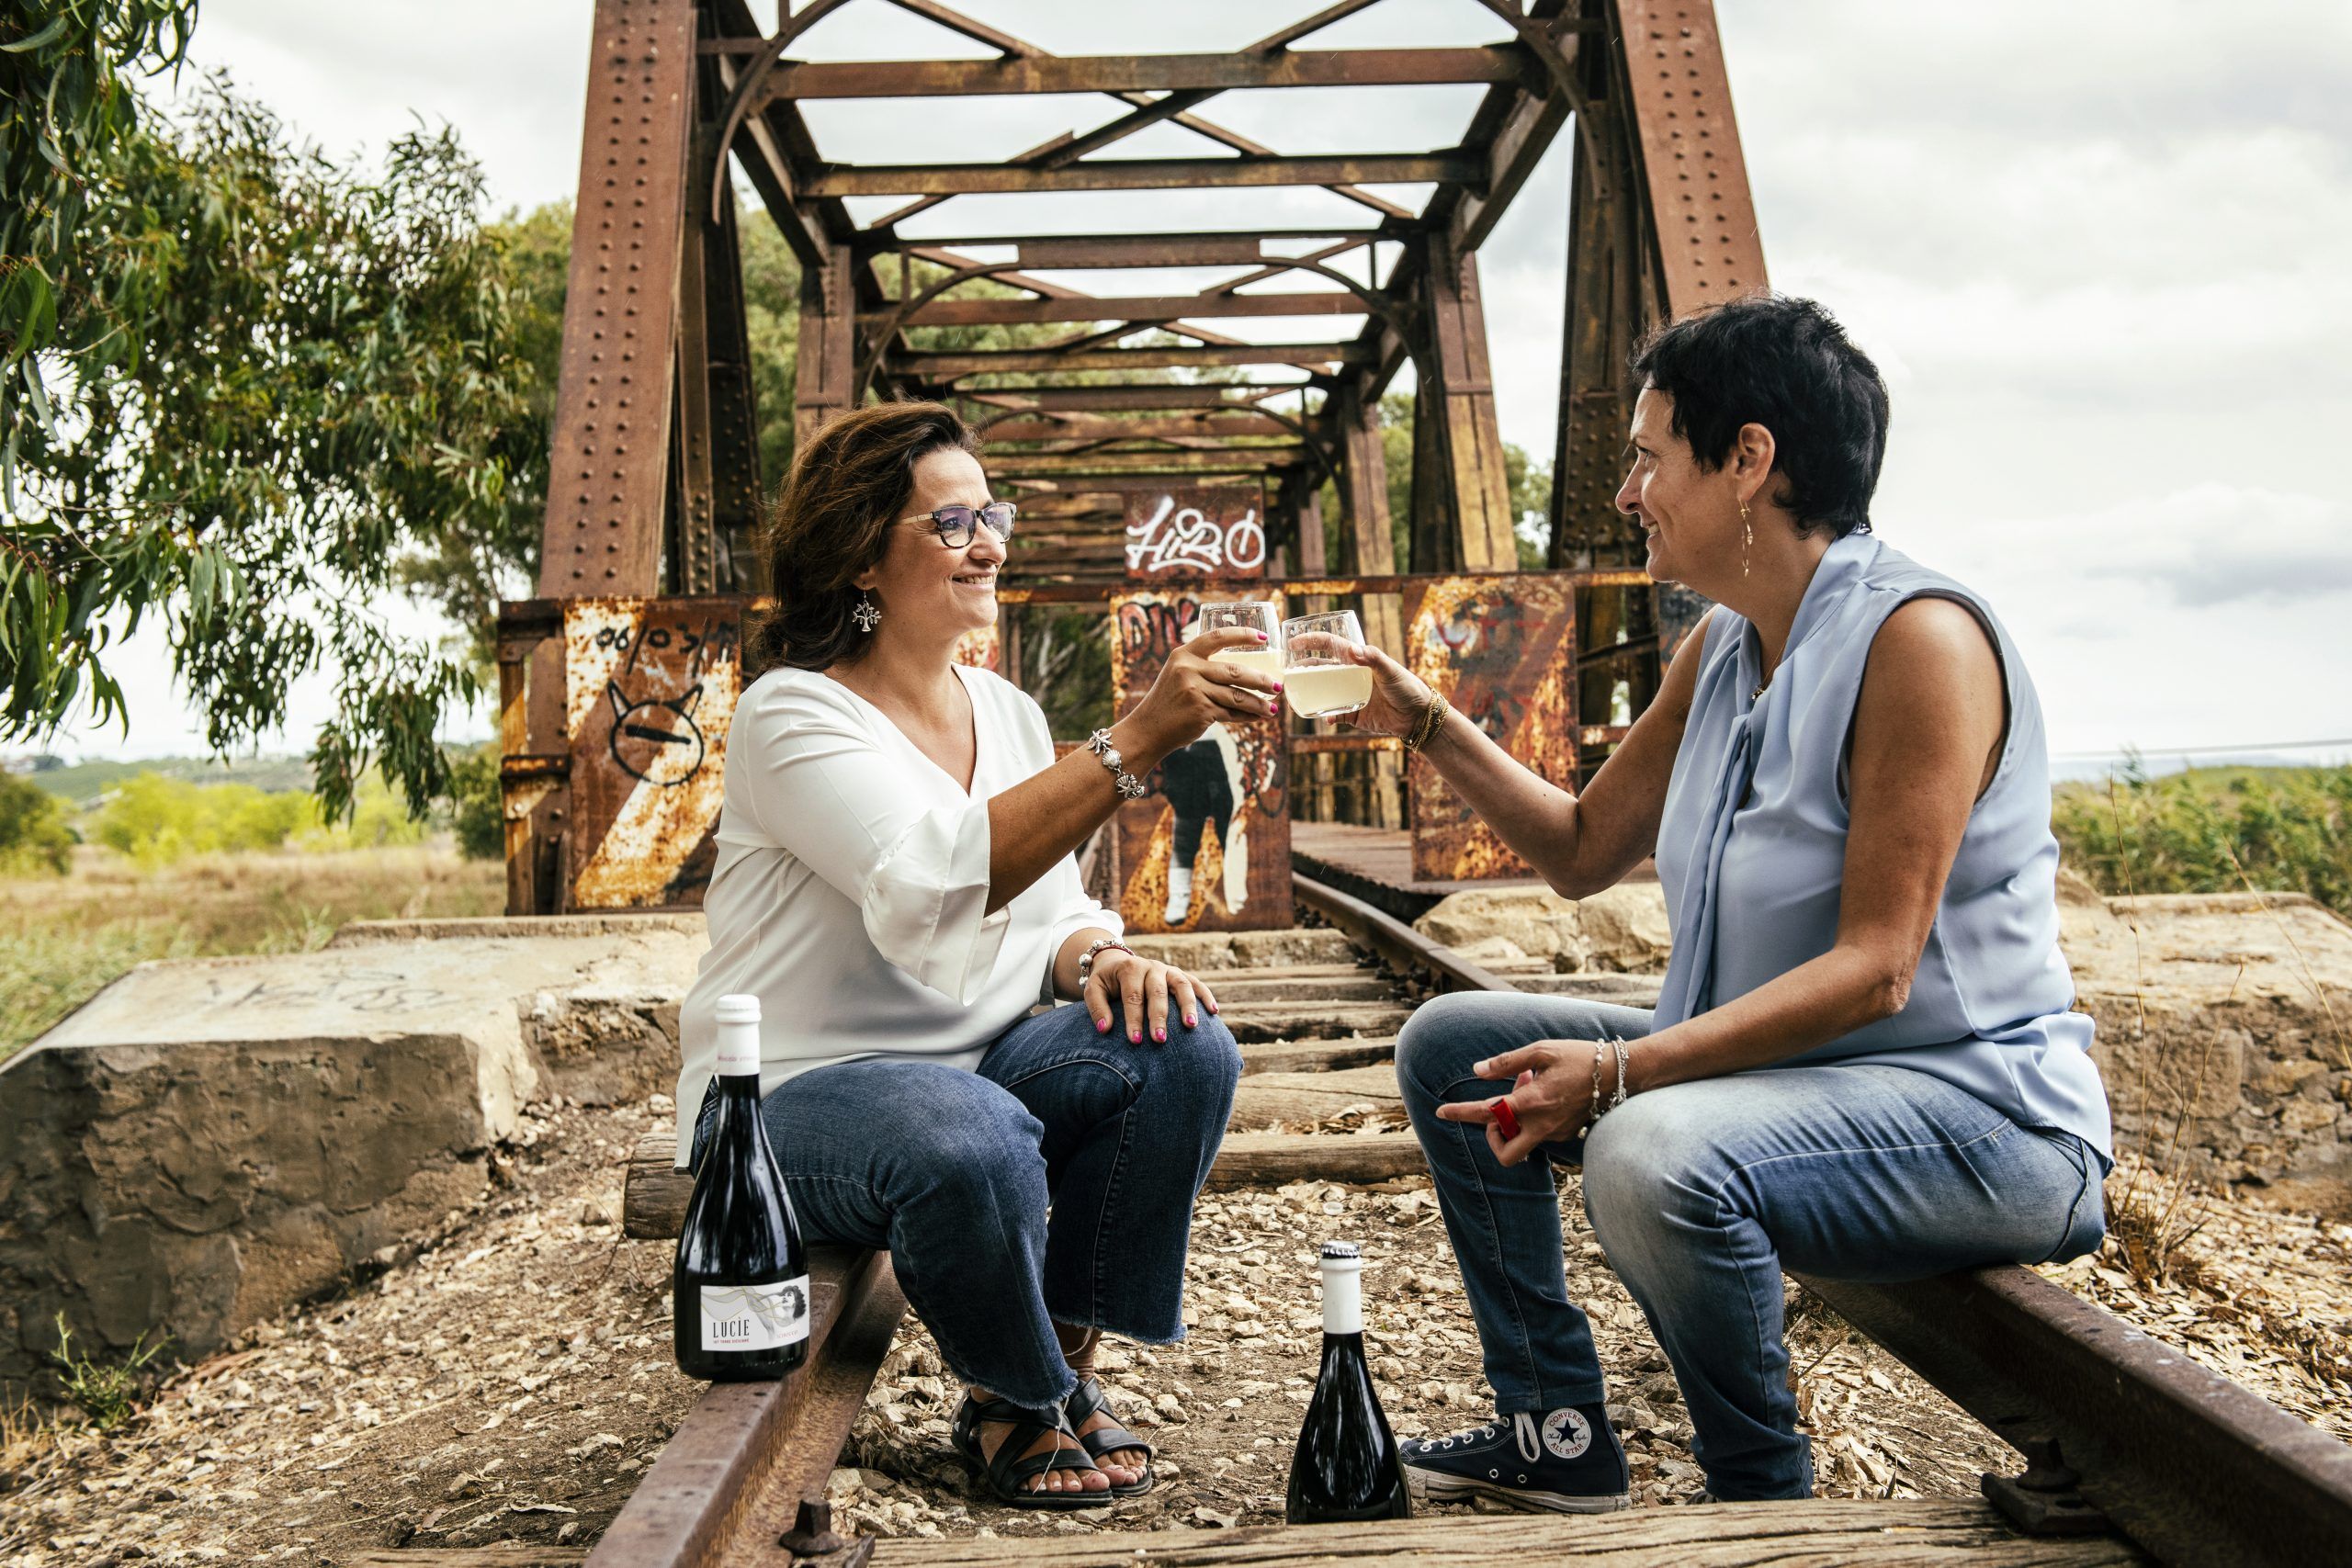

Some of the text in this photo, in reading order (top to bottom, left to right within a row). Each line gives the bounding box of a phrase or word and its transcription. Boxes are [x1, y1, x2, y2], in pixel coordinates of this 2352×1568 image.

[1549, 1412, 1585, 1427] CONVERSE
[1551, 1442, 1584, 1455] ALL STAR
